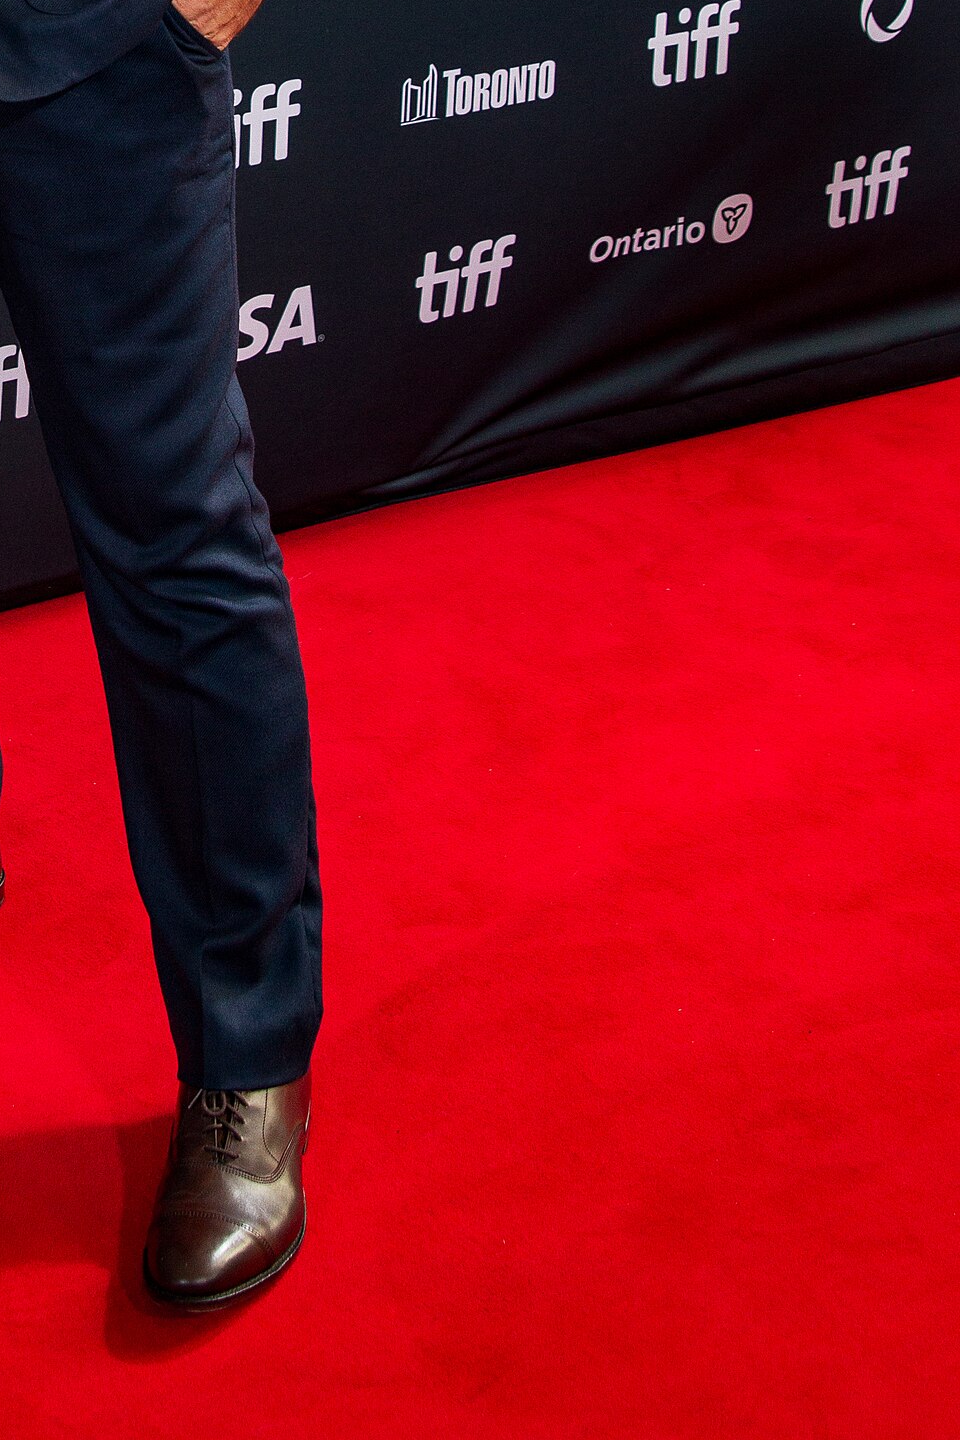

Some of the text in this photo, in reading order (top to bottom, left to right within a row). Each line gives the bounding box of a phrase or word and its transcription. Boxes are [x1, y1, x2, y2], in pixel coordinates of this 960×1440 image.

[442, 59, 557, 119] TORONTO
[825, 145, 912, 229] tiff
[590, 216, 706, 263] Ontario
[415, 233, 517, 324] tiff
